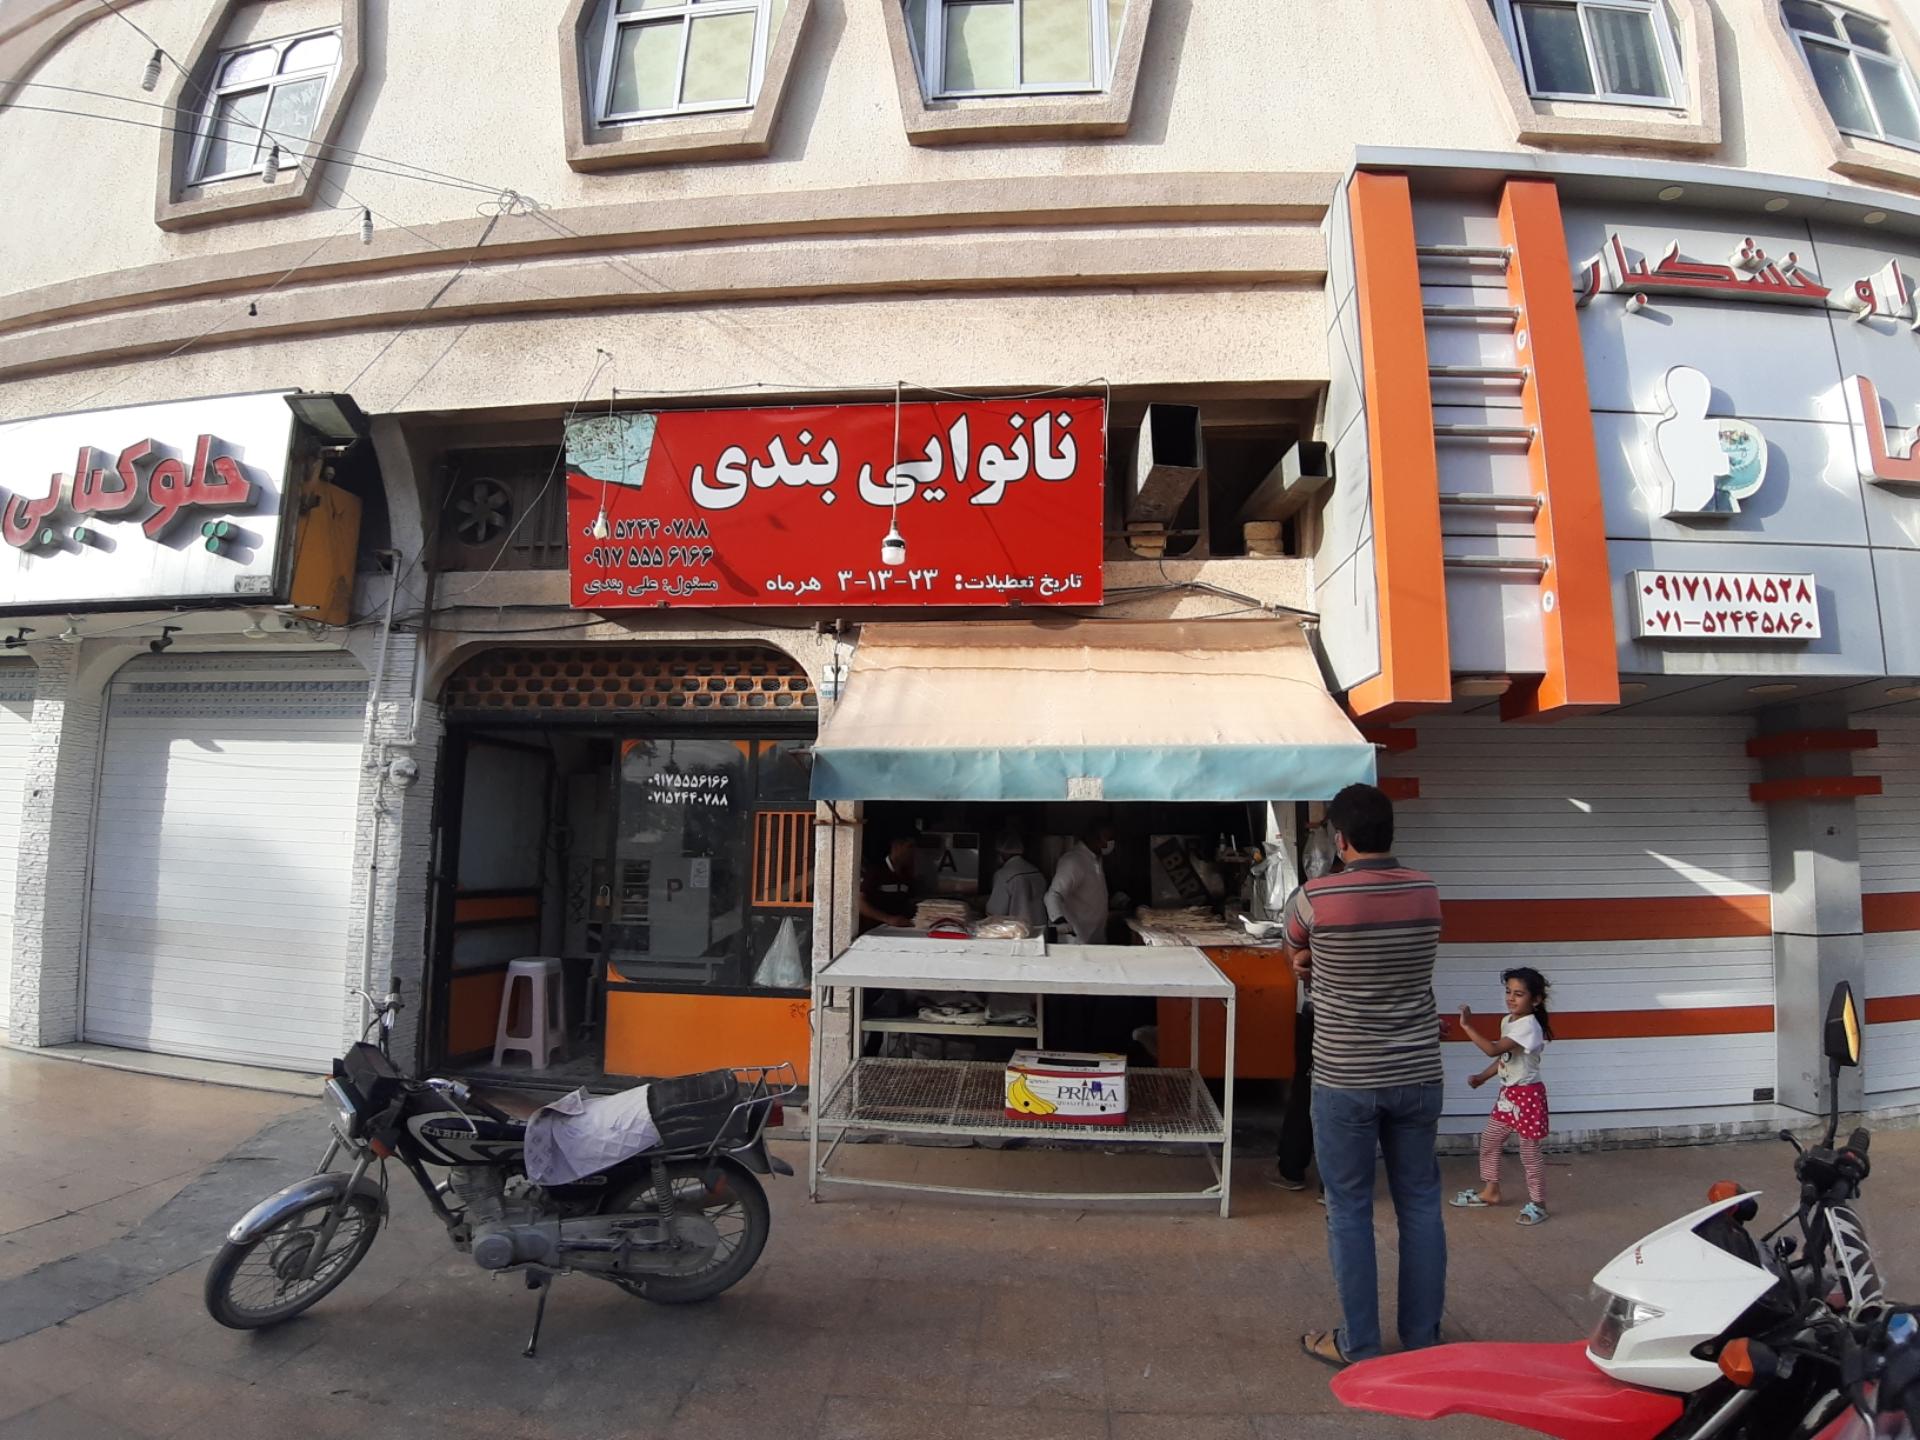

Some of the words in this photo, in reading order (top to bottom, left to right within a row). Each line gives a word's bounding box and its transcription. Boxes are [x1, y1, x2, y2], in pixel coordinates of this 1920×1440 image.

[691, 427, 840, 510] بندی
[857, 411, 1078, 507] نانوایی
[584, 577, 624, 596] بندی
[627, 576, 659, 596] علی
[1039, 574, 1082, 595] تاریخ
[1643, 574, 1812, 604] ۰۹۱۷۱۸۱۸۵۲۸
[648, 773, 729, 789] ۰۹۱۷۵۵۵۶۱۶۶
[648, 791, 728, 806] ۰۷۱۵۲۴۴۰۷۸۸
[938, 850, 958, 873] A
[1057, 1081, 1119, 1101] PRIMA
